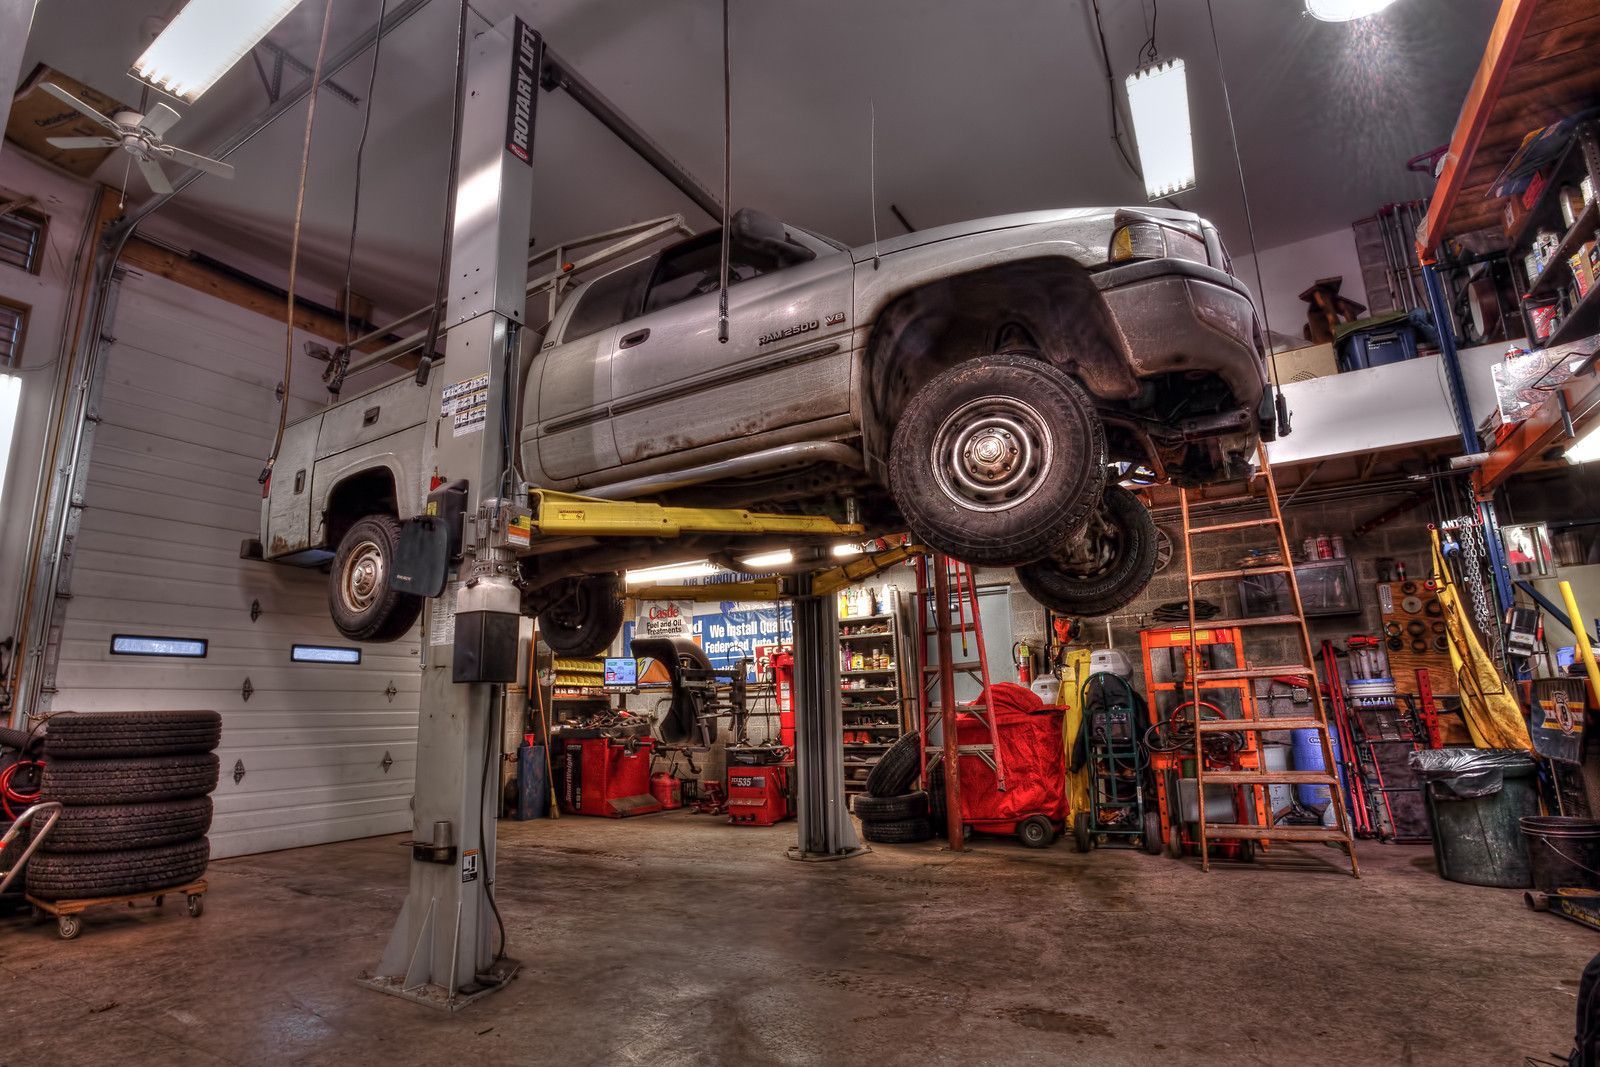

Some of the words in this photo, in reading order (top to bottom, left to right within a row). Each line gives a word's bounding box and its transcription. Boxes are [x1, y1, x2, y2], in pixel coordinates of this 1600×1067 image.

[520, 24, 537, 70] LIFT
[513, 66, 532, 149] ROTARY
[646, 620, 660, 630] Fuel
[660, 619, 672, 628] and
[672, 618, 682, 628] Oil
[646, 626, 682, 637] Treatments
[709, 624, 725, 639] We
[727, 620, 758, 637] Install
[760, 617, 793, 636] Quality
[705, 639, 750, 655] Federated
